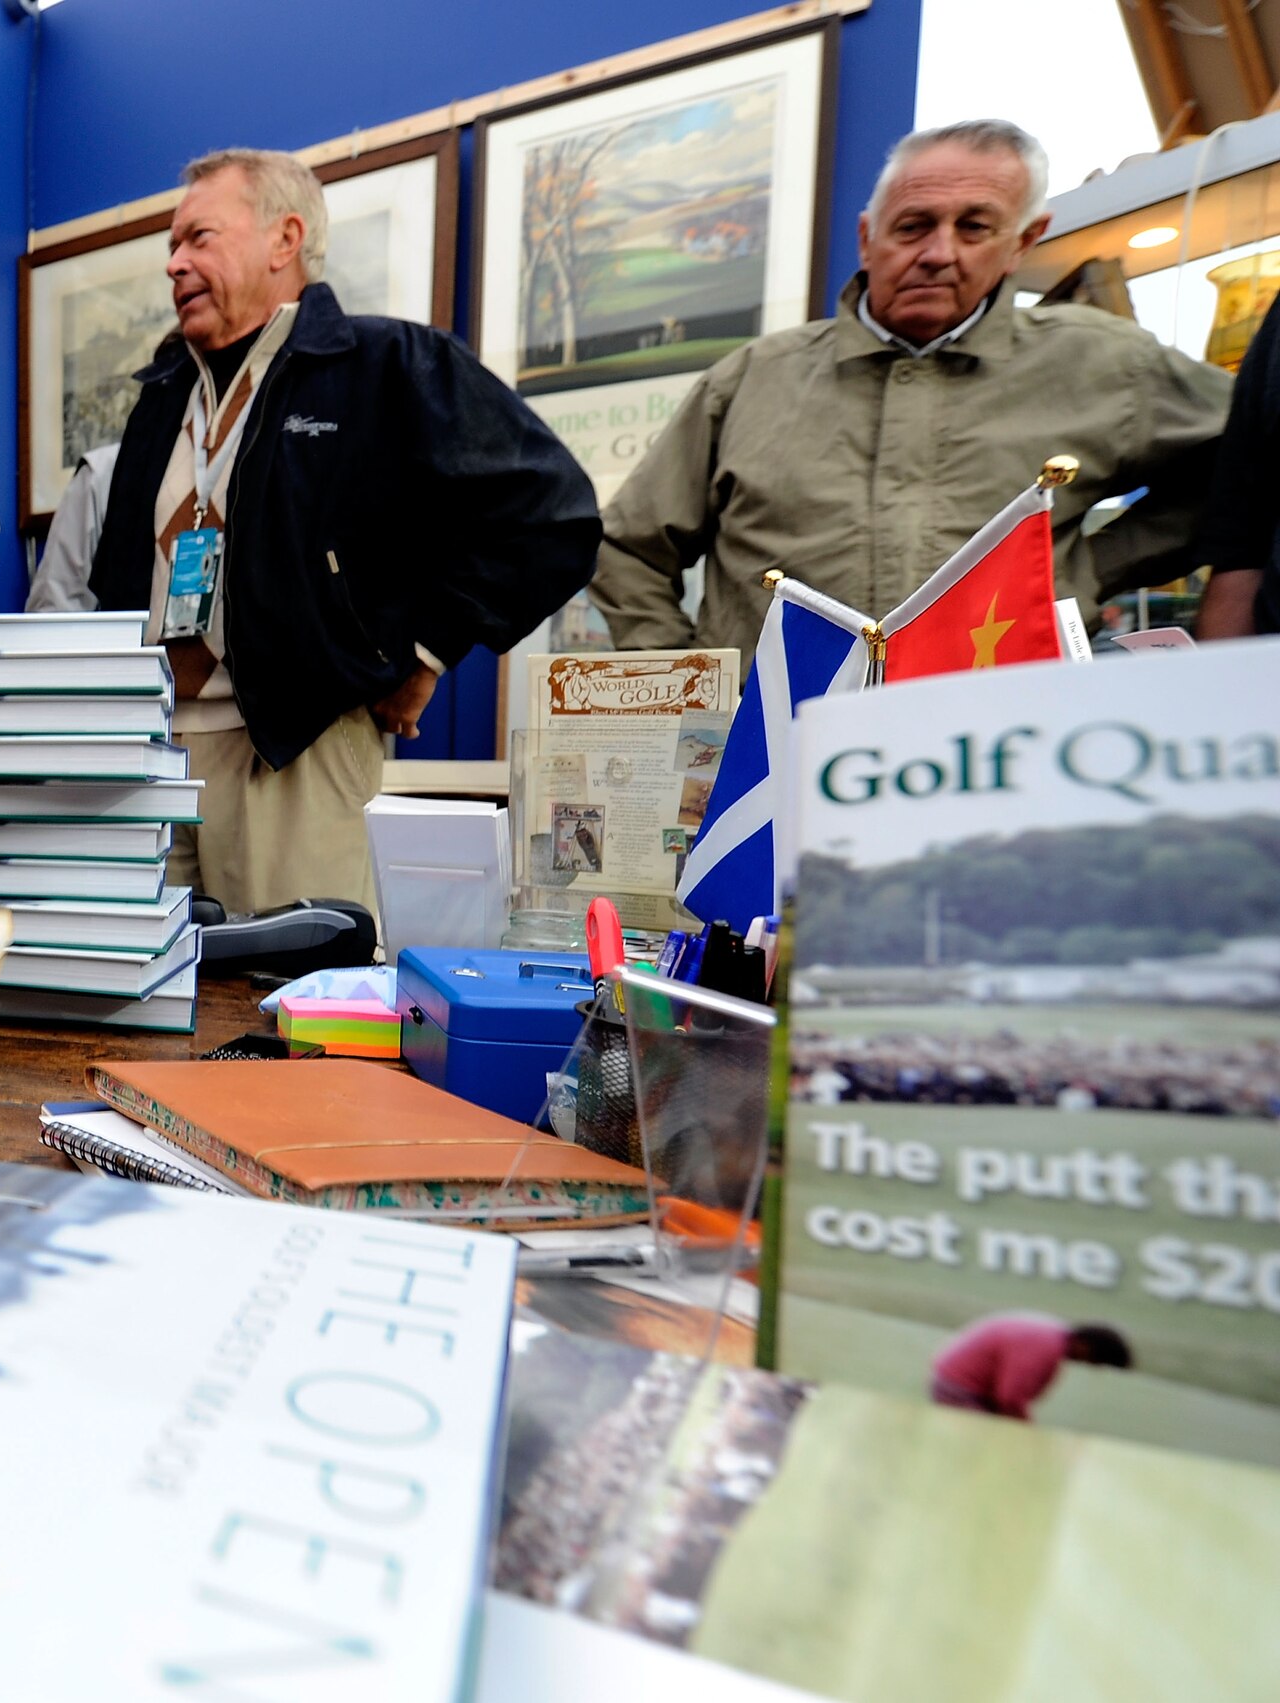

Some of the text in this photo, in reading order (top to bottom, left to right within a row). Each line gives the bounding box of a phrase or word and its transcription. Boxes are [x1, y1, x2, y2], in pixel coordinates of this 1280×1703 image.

[608, 404, 639, 427] to
[592, 679, 646, 693] WORLD
[620, 684, 677, 705] GOLF
[817, 719, 1280, 806] Golf Qua
[808, 1121, 942, 1184] The
[957, 1146, 1150, 1207] putt
[806, 1204, 963, 1266] cost
[980, 1229, 1119, 1288] me
[319, 1235, 476, 1357] THE
